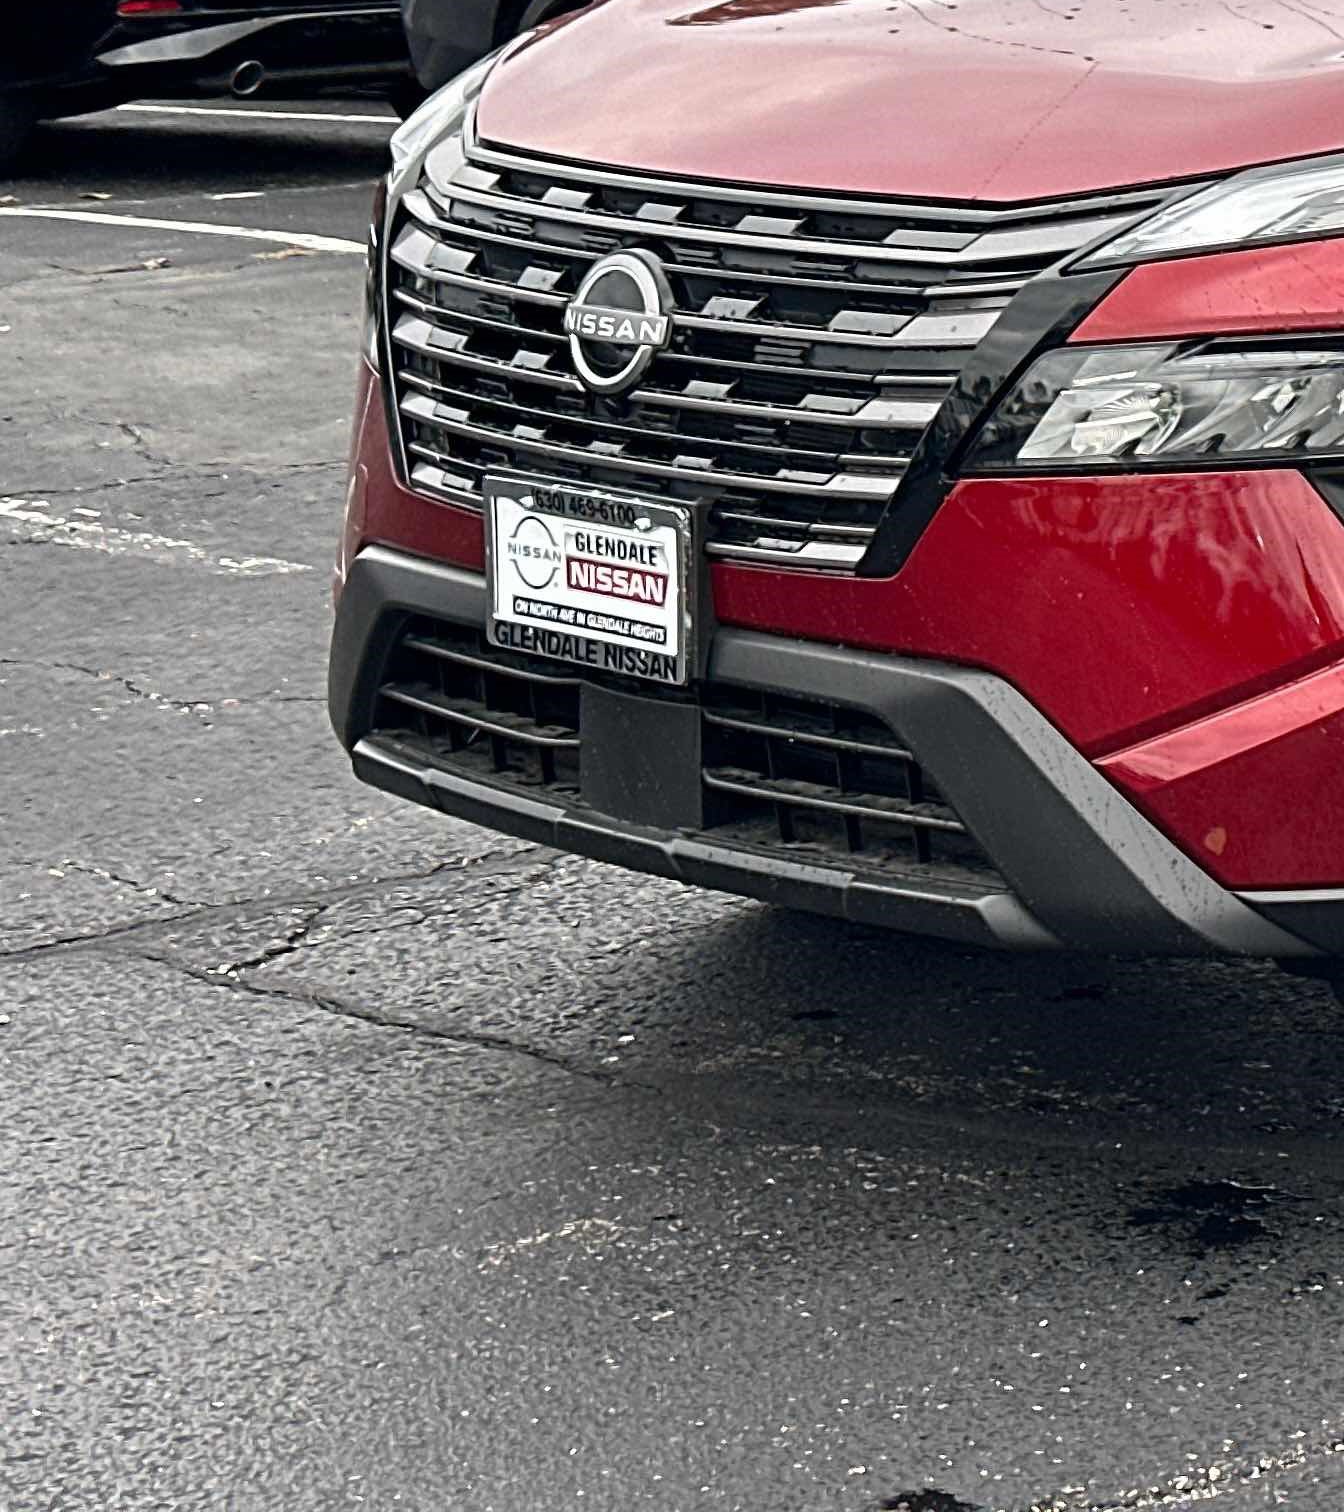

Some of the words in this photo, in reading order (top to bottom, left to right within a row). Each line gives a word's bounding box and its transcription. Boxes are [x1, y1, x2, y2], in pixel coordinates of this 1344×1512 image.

[565, 308, 662, 343] NISSAN
[507, 541, 562, 563] NISSAN
[575, 532, 658, 567] GLENDALE
[570, 561, 664, 603] NISSAN
[586, 613, 630, 634] GLENDALE
[630, 622, 665, 642] HEIGHTS
[495, 623, 599, 663] GLENDALE
[604, 644, 678, 682] NISSAN
